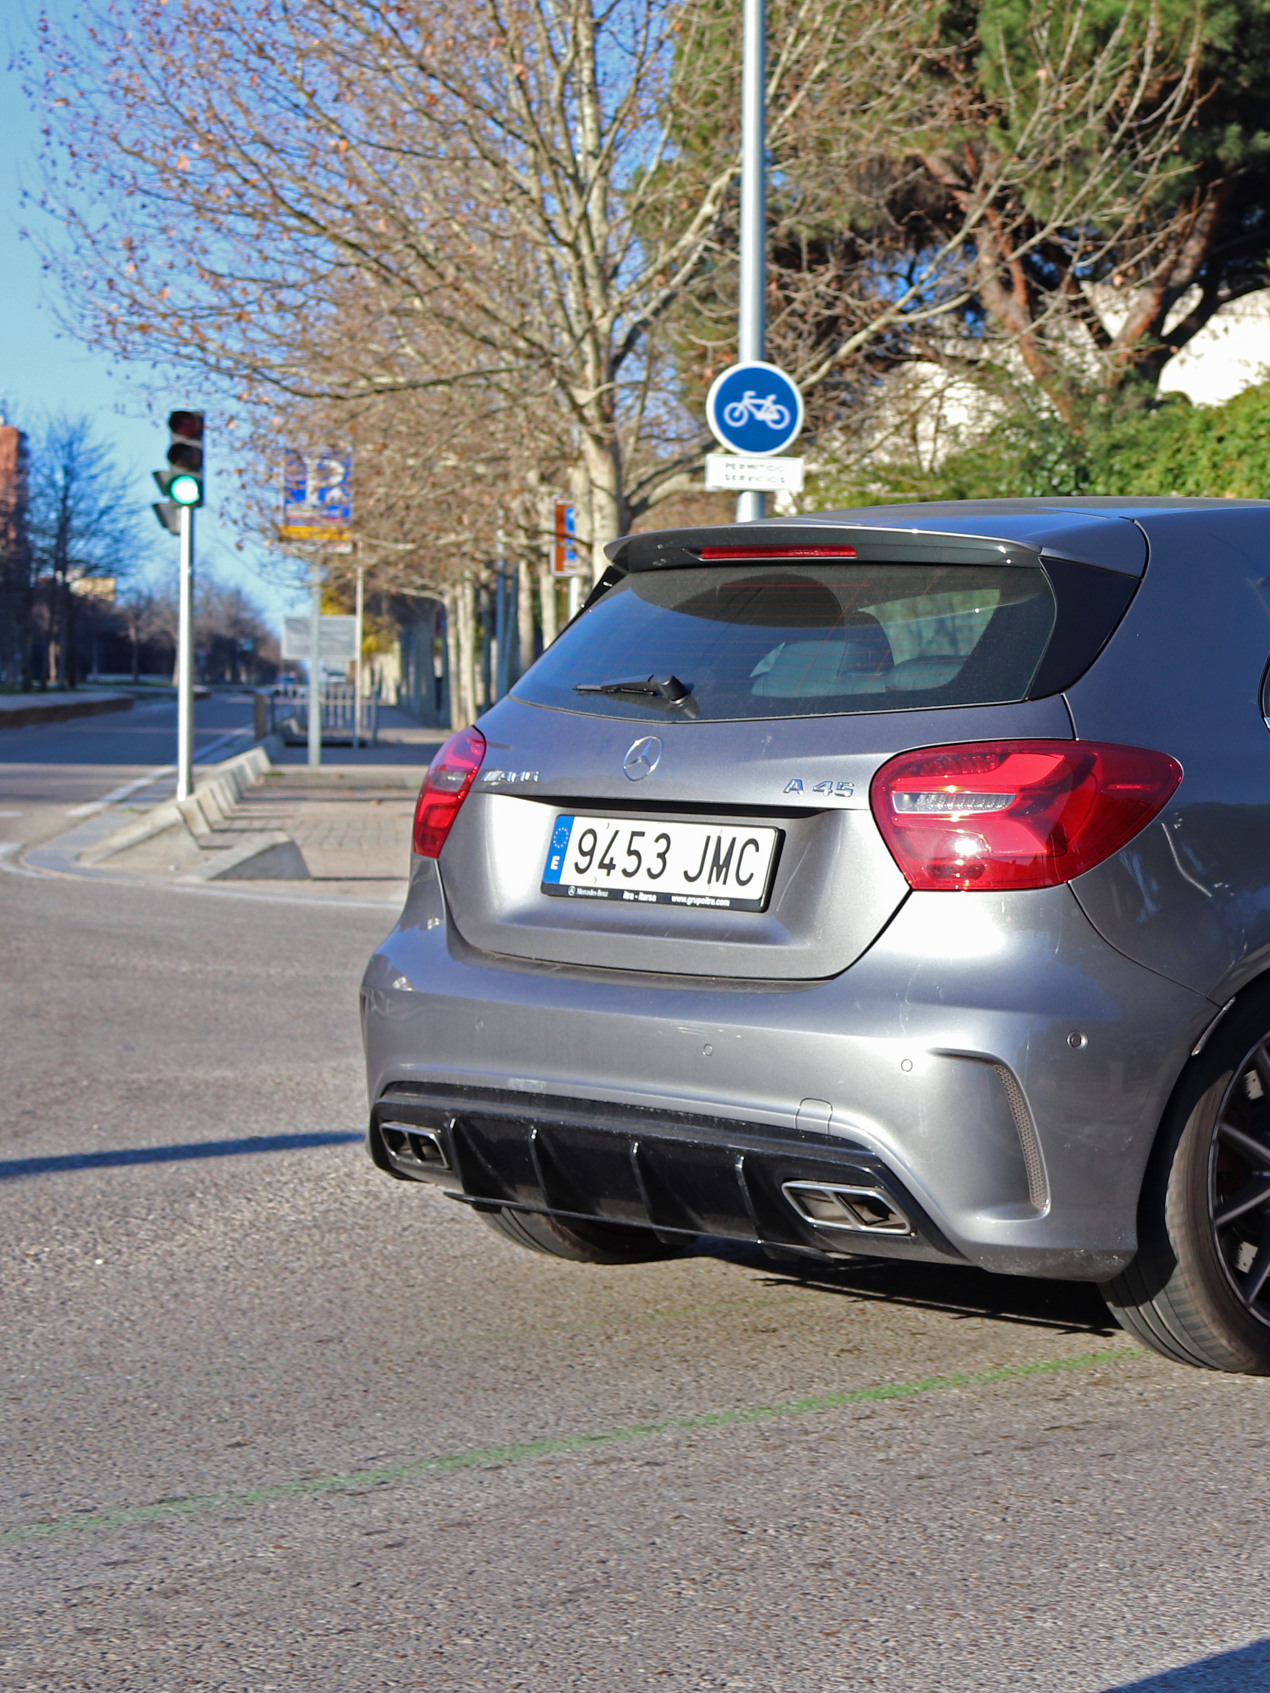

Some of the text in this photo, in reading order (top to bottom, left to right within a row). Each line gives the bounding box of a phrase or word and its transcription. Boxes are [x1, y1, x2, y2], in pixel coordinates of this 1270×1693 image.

[783, 778, 855, 798] A 45
[550, 855, 561, 870] E
[573, 827, 760, 887] 9453 JMC
